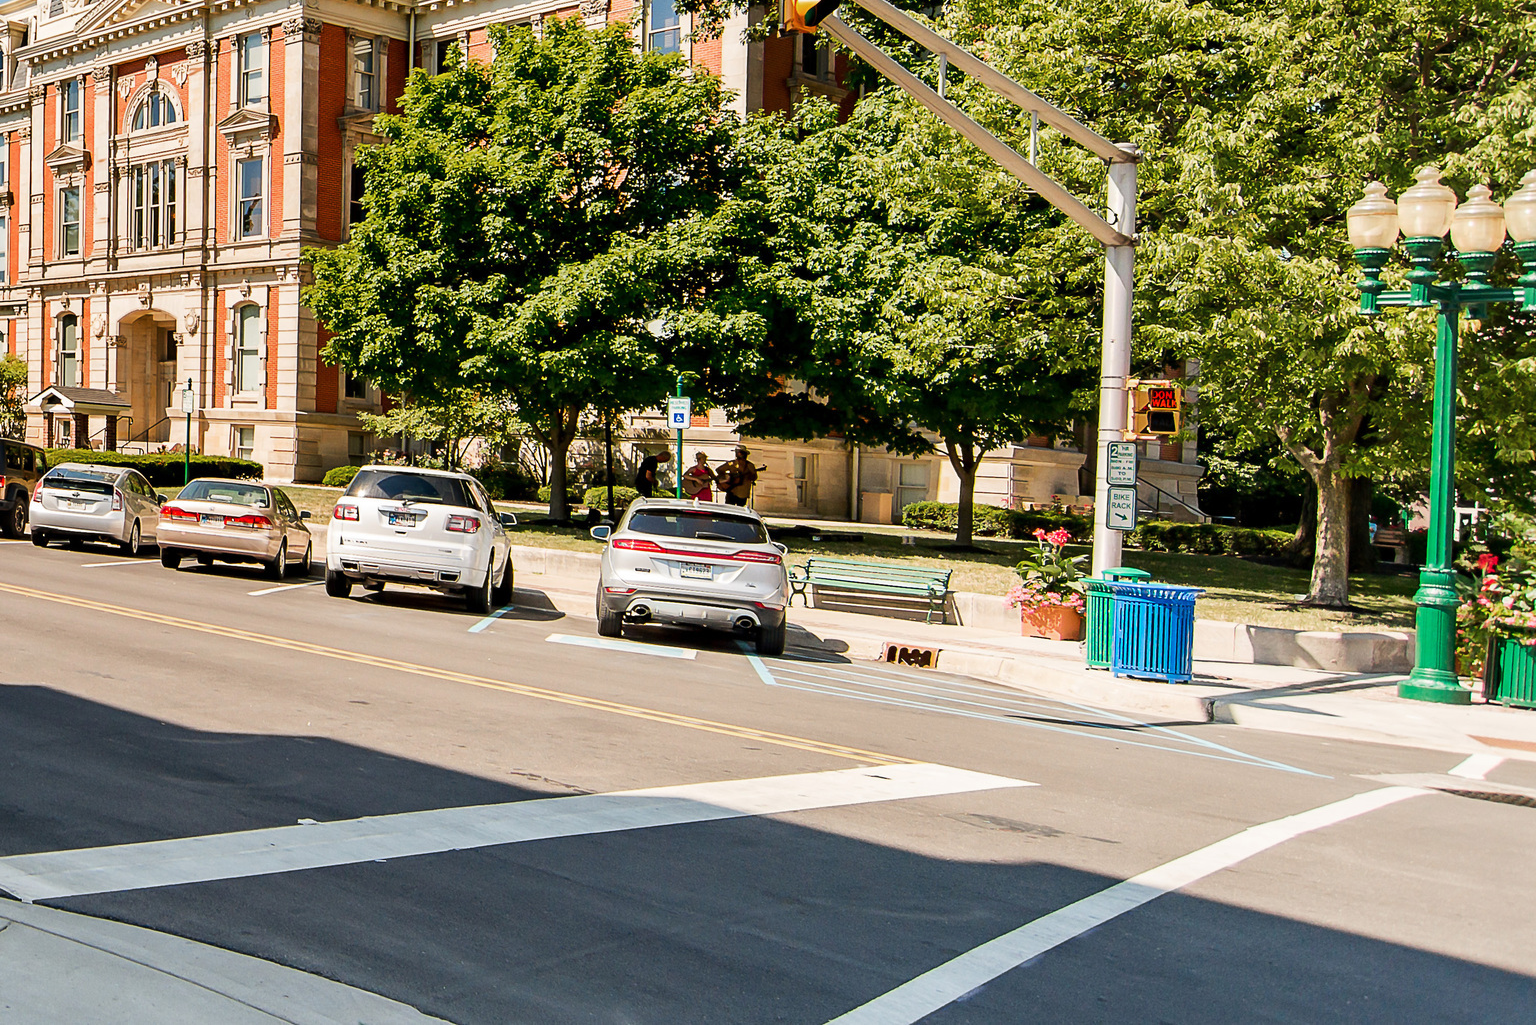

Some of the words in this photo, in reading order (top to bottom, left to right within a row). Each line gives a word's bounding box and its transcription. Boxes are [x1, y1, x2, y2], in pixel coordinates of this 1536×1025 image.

[1152, 399, 1177, 408] WALK
[1111, 446, 1118, 456] 2
[1113, 493, 1130, 501] BIKE
